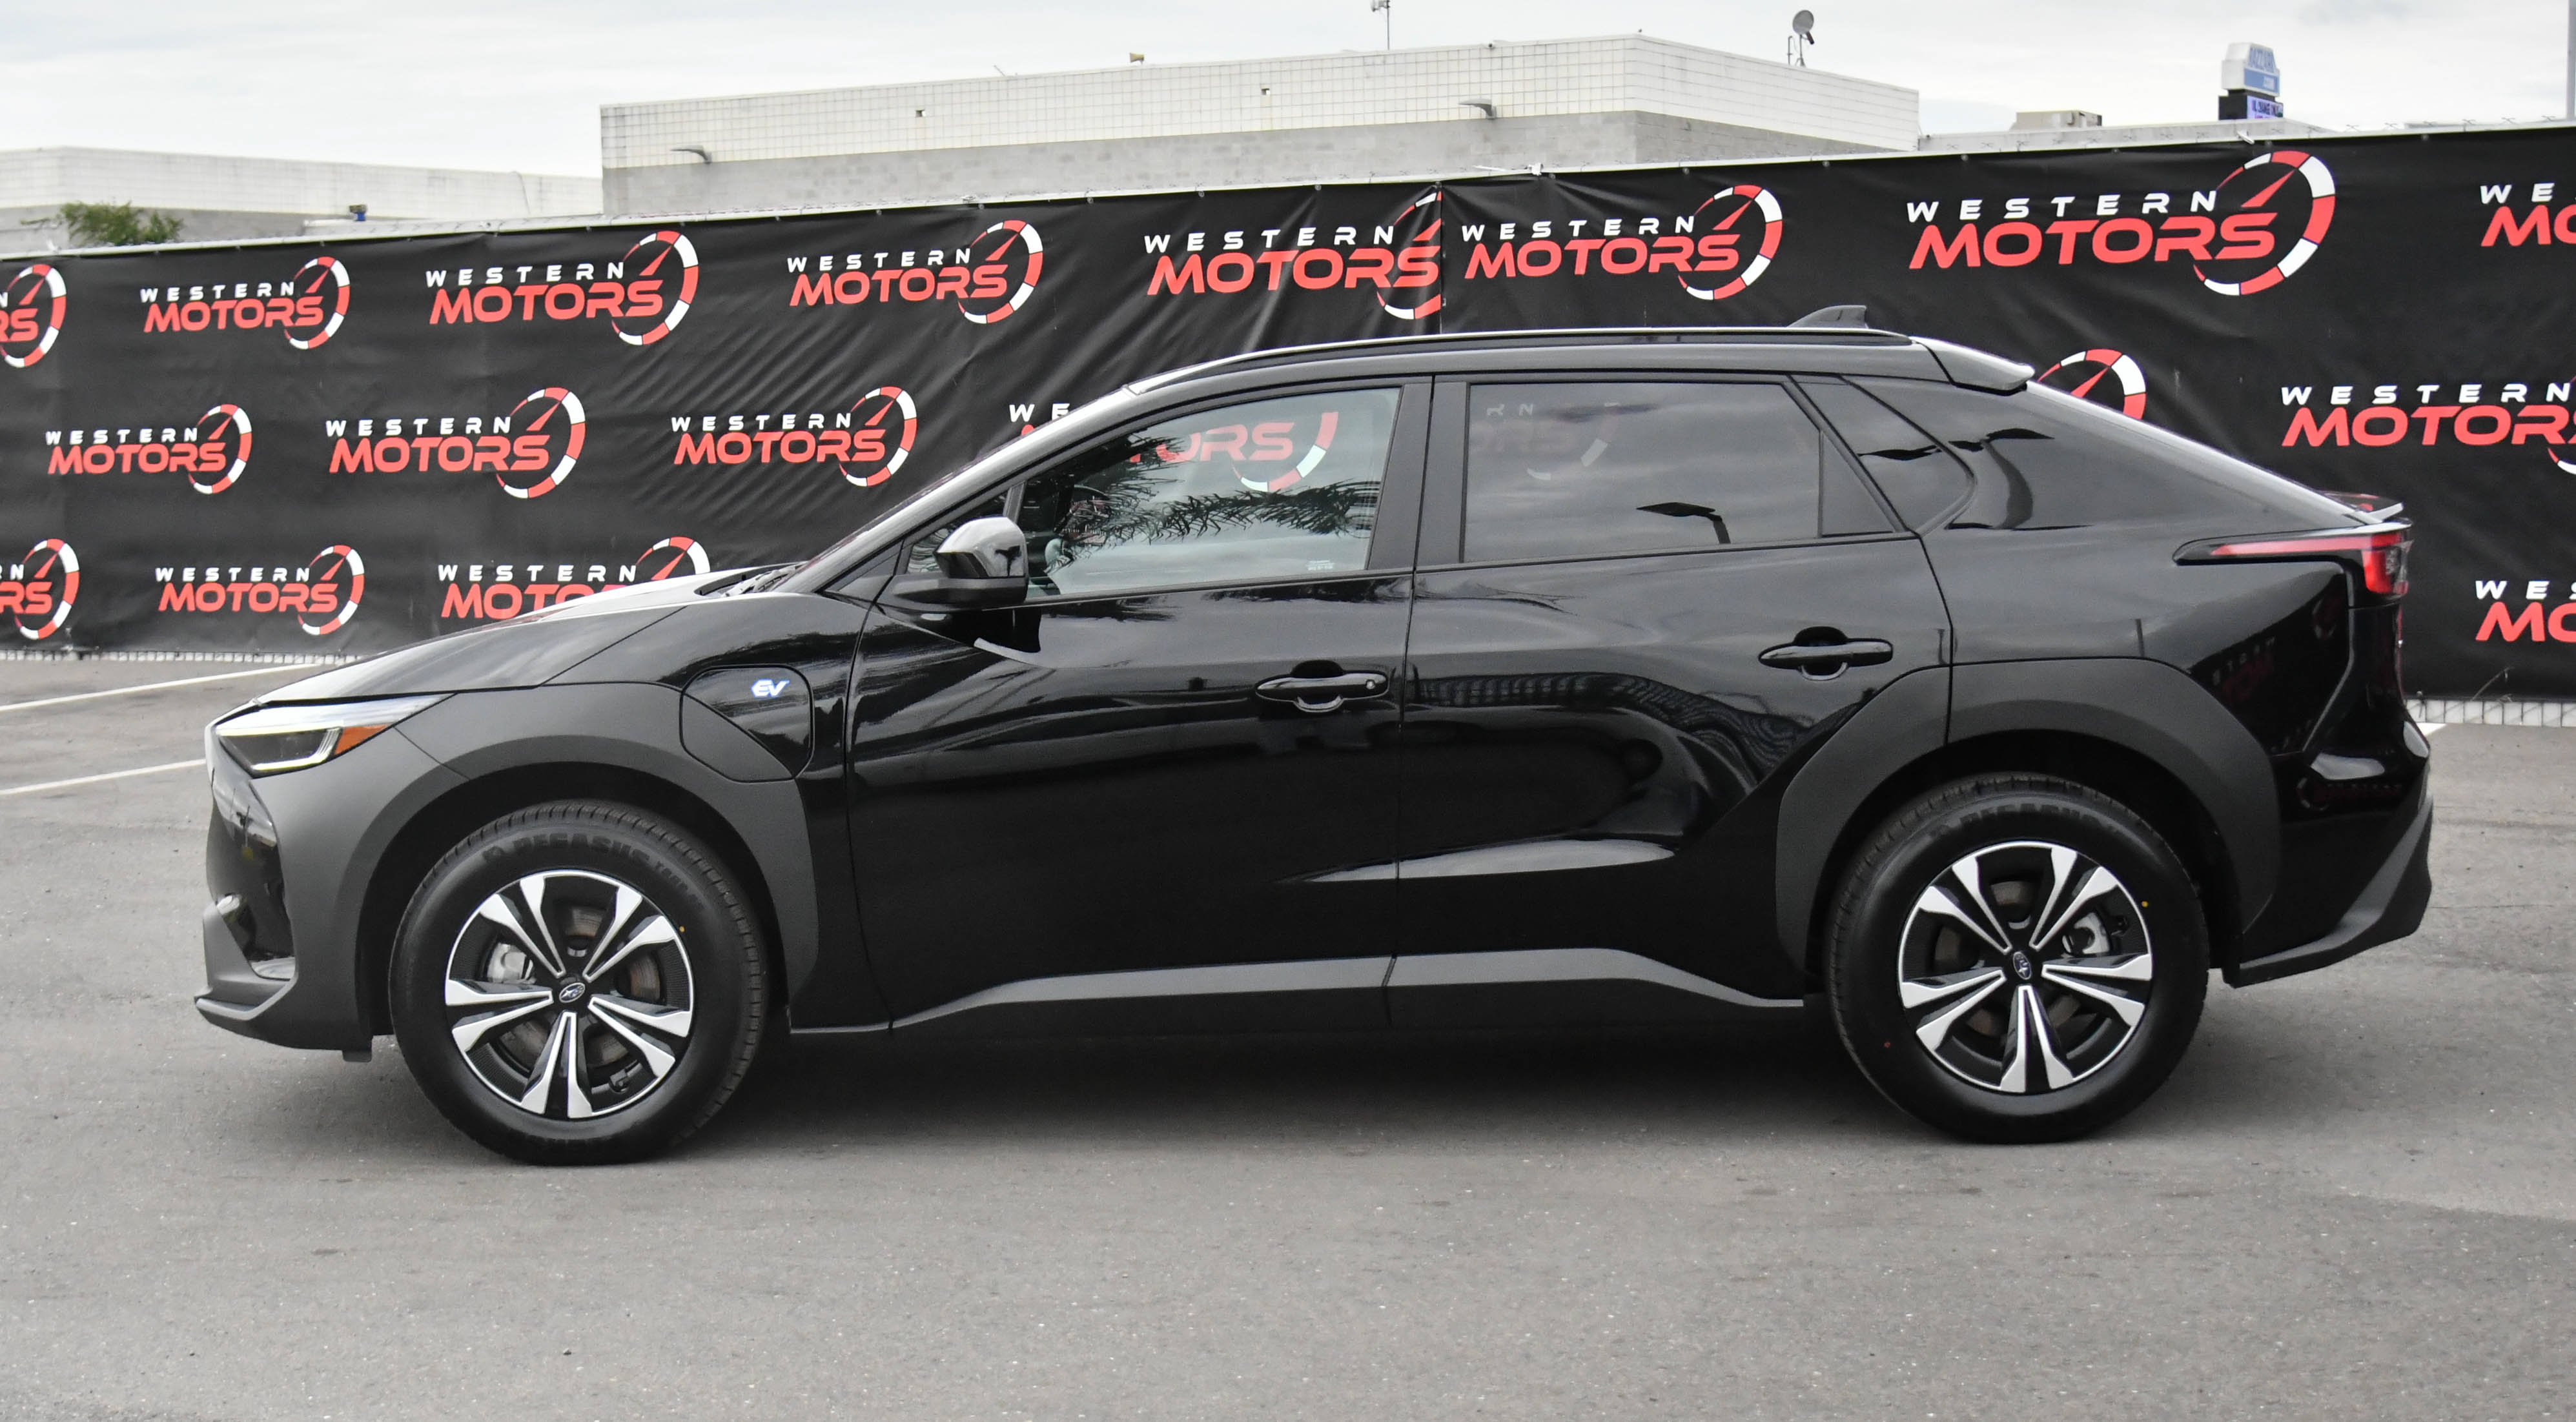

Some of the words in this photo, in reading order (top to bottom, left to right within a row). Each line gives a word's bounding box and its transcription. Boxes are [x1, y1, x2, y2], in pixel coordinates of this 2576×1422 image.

[2479, 182, 2576, 204] WE
[1906, 190, 2216, 223] WESTERN
[1143, 225, 1394, 254] WESTERN
[1461, 216, 1694, 242] WESTERN
[1907, 212, 2279, 270] MOTORS
[786, 248, 970, 273] WESTERN
[1464, 234, 1741, 279] MOTORS
[425, 261, 624, 287] WESTERN
[1146, 245, 1441, 296] MOTORS
[139, 281, 294, 303] WESTERN
[789, 264, 1008, 307] MOTORS
[143, 296, 324, 333] MOTORS
[429, 279, 664, 325] MOTORS
[2280, 382, 2571, 405] WESTERN
[325, 416, 511, 437] WESTERN
[670, 412, 851, 432] WESTERN
[2281, 404, 2576, 447] MOTOR
[45, 427, 198, 445] WESTERN
[673, 429, 886, 465] MOTORS
[47, 442, 227, 475] MOTORS
[328, 434, 550, 474] MOTORS
[0, 564, 25, 580] N
[154, 567, 310, 582] WESTERN
[437, 564, 637, 582] WESTERN
[157, 582, 338, 613] MOTORS
[2475, 580, 2576, 600] WE
[751, 679, 790, 698] EV
